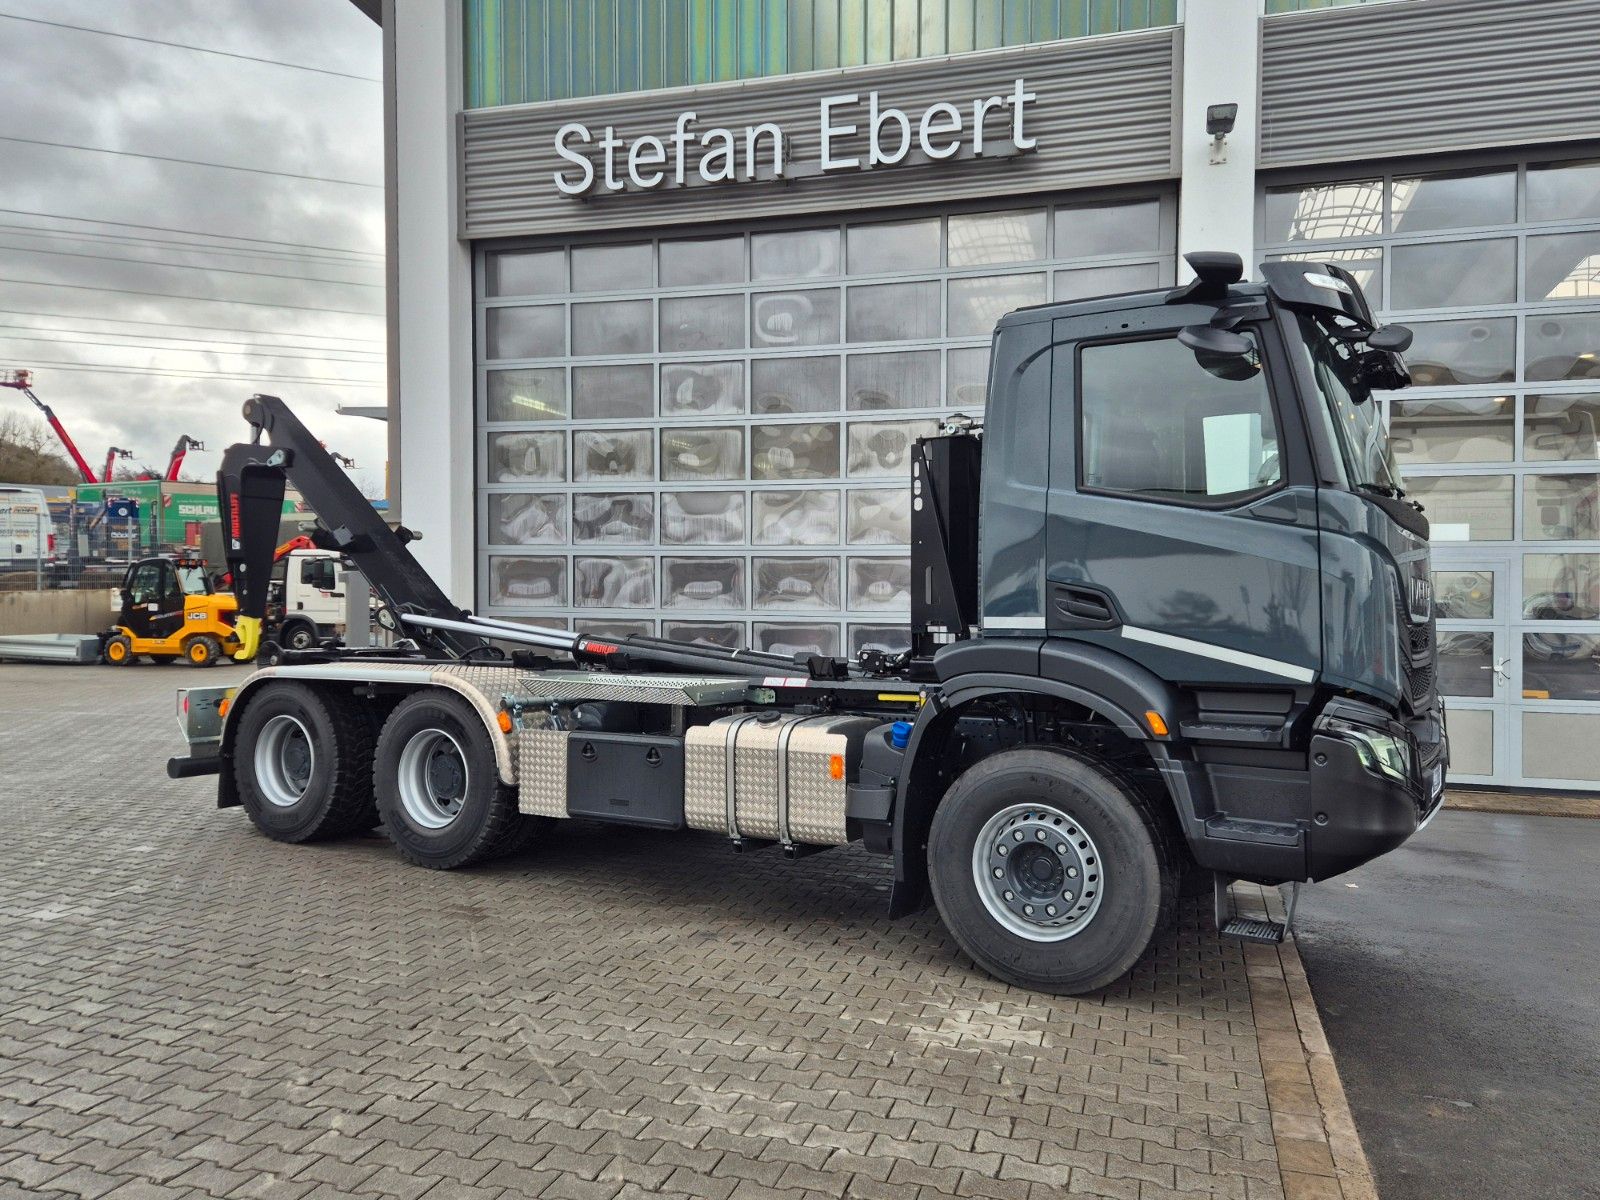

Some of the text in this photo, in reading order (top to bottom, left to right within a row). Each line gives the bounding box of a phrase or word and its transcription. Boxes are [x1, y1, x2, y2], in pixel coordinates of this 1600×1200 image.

[553, 78, 1037, 195] Stefan Ebert
[187, 612, 208, 620] JCB
